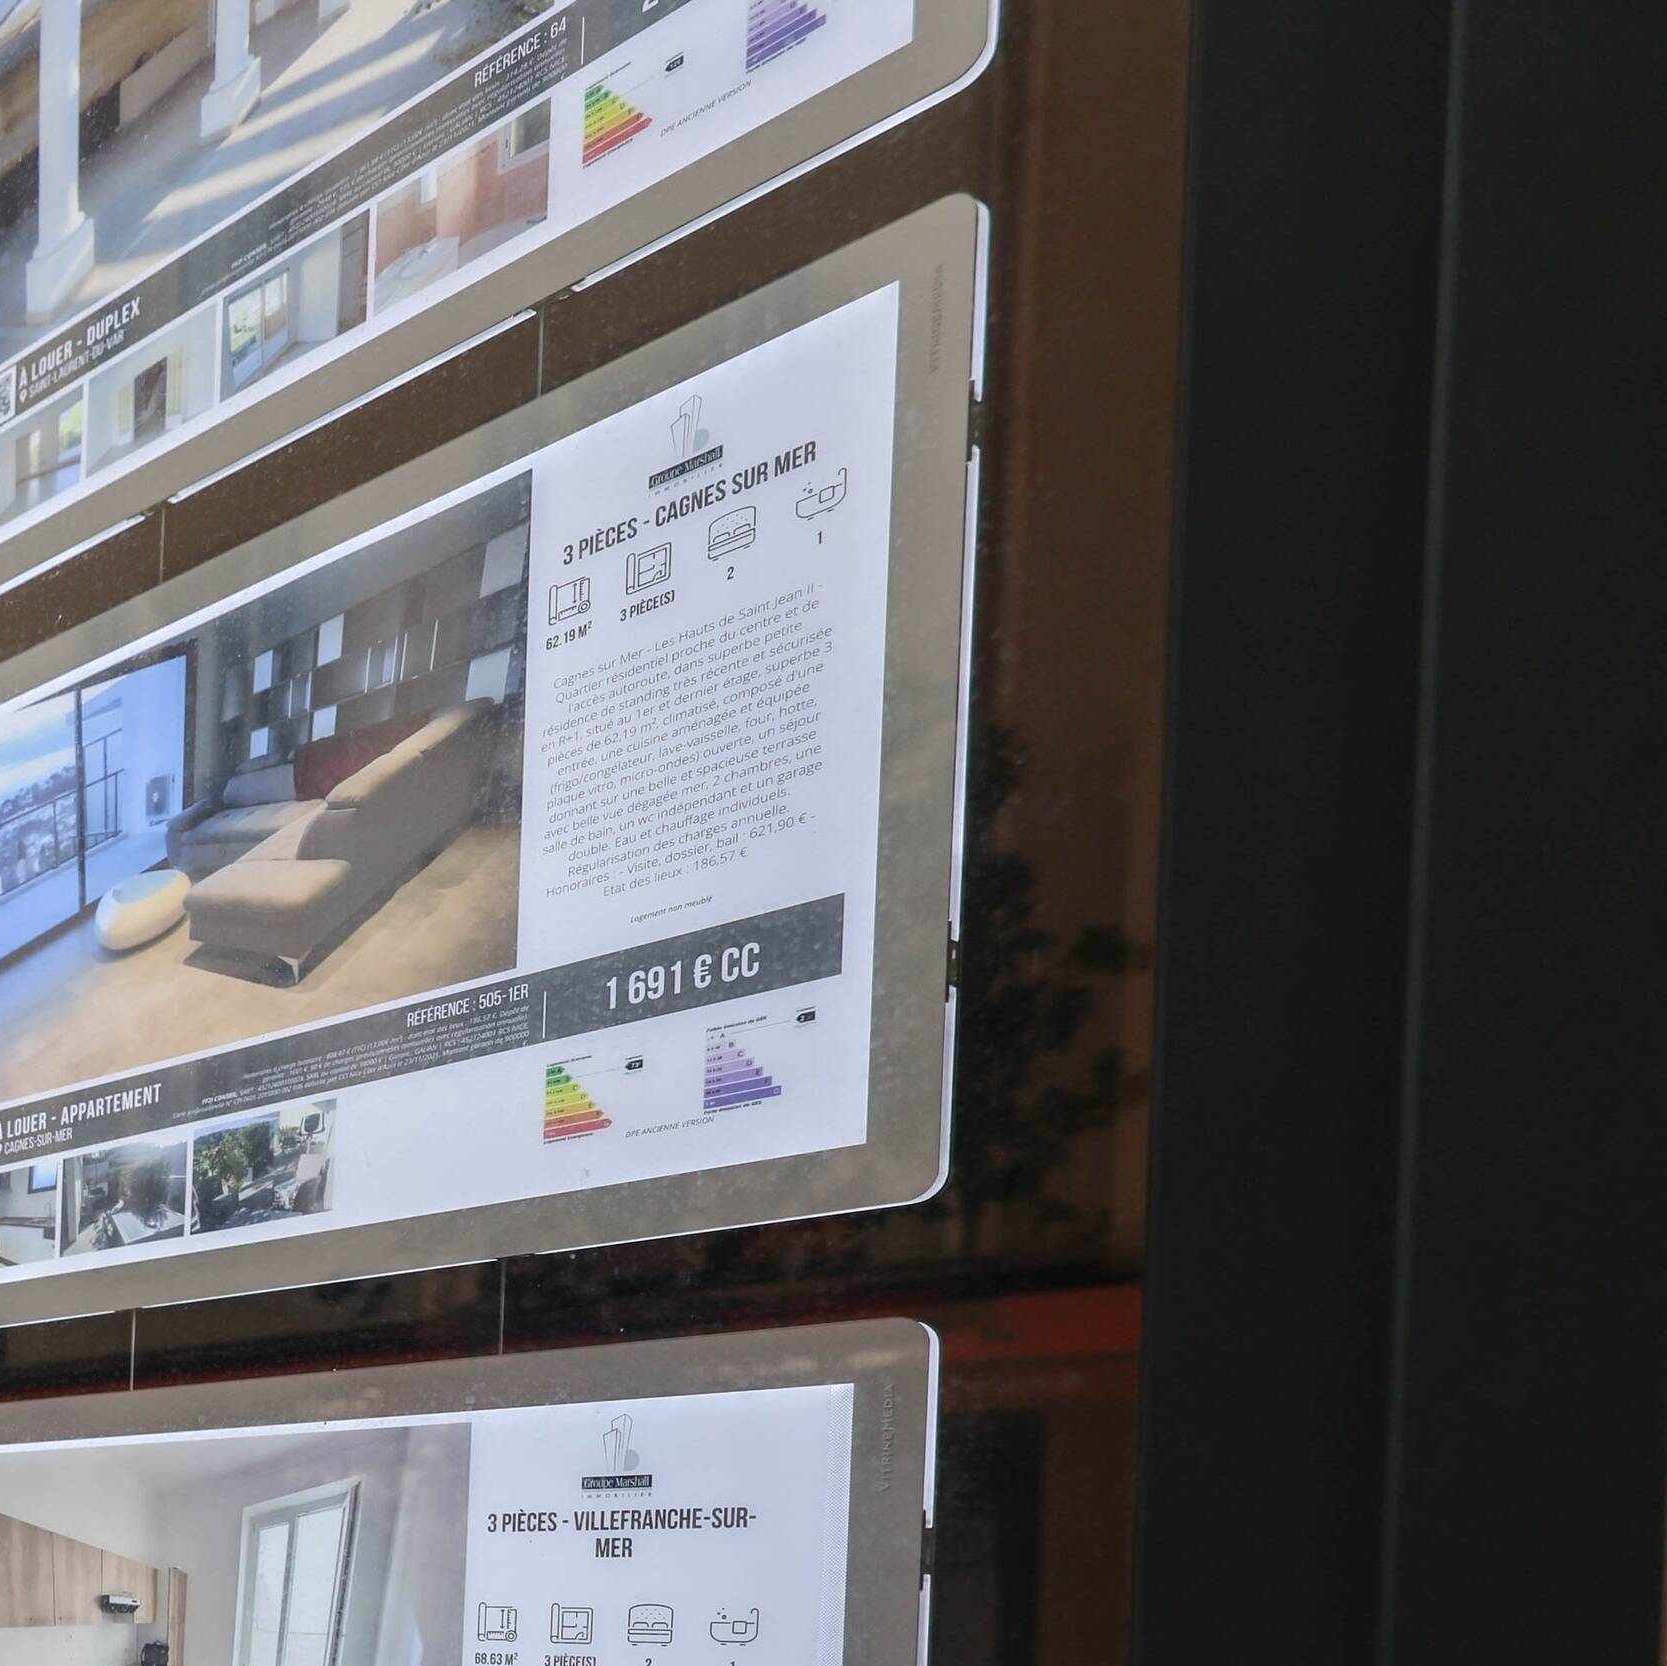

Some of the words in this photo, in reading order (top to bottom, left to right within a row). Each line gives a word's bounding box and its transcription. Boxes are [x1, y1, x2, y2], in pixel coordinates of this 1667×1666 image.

[474, 31, 541, 88] RÉFÉRENCE
[549, 16, 567, 39] 64
[19, 364, 28, 387] À
[31, 339, 72, 381] LOUER
[86, 295, 141, 346] DUPLEX
[29, 329, 125, 398] SAINT-LAURENT-DU-VAR
[562, 543, 574, 566] 3
[578, 516, 638, 560] PIÈCES
[654, 478, 727, 527] CAGNES
[731, 461, 768, 495] SUR
[773, 440, 816, 478] MER
[727, 566, 734, 581] 2
[619, 608, 627, 622] 3
[629, 588, 675, 619] PIÈCE(S)
[545, 628, 576, 651] 62.19
[577, 623, 592, 639] M²
[605, 975, 617, 1010] 1
[628, 959, 682, 1004] 691
[692, 953, 712, 989] €
[720, 941, 760, 983] CC
[406, 997, 470, 1028] RÉFÉRENCE
[478, 982, 529, 1010] 505-1ER
[6, 1111, 47, 1139] LOUER
[60, 1082, 162, 1126] APPARTEMENT
[4, 1129, 73, 1155] CAGNES-SUR-MER
[583, 1477, 614, 1490] Groupe
[615, 1475, 651, 1488] Marshall
[487, 1512, 497, 1533] 3
[501, 1508, 558, 1533] PIÈCES
[573, 1506, 757, 1531] VILLEFRANCHE-SUR-
[594, 1537, 633, 1558] MER
[474, 1651, 503, 1666] 68.63
[504, 1651, 519, 1666] M²
[543, 1654, 551, 1666] 3
